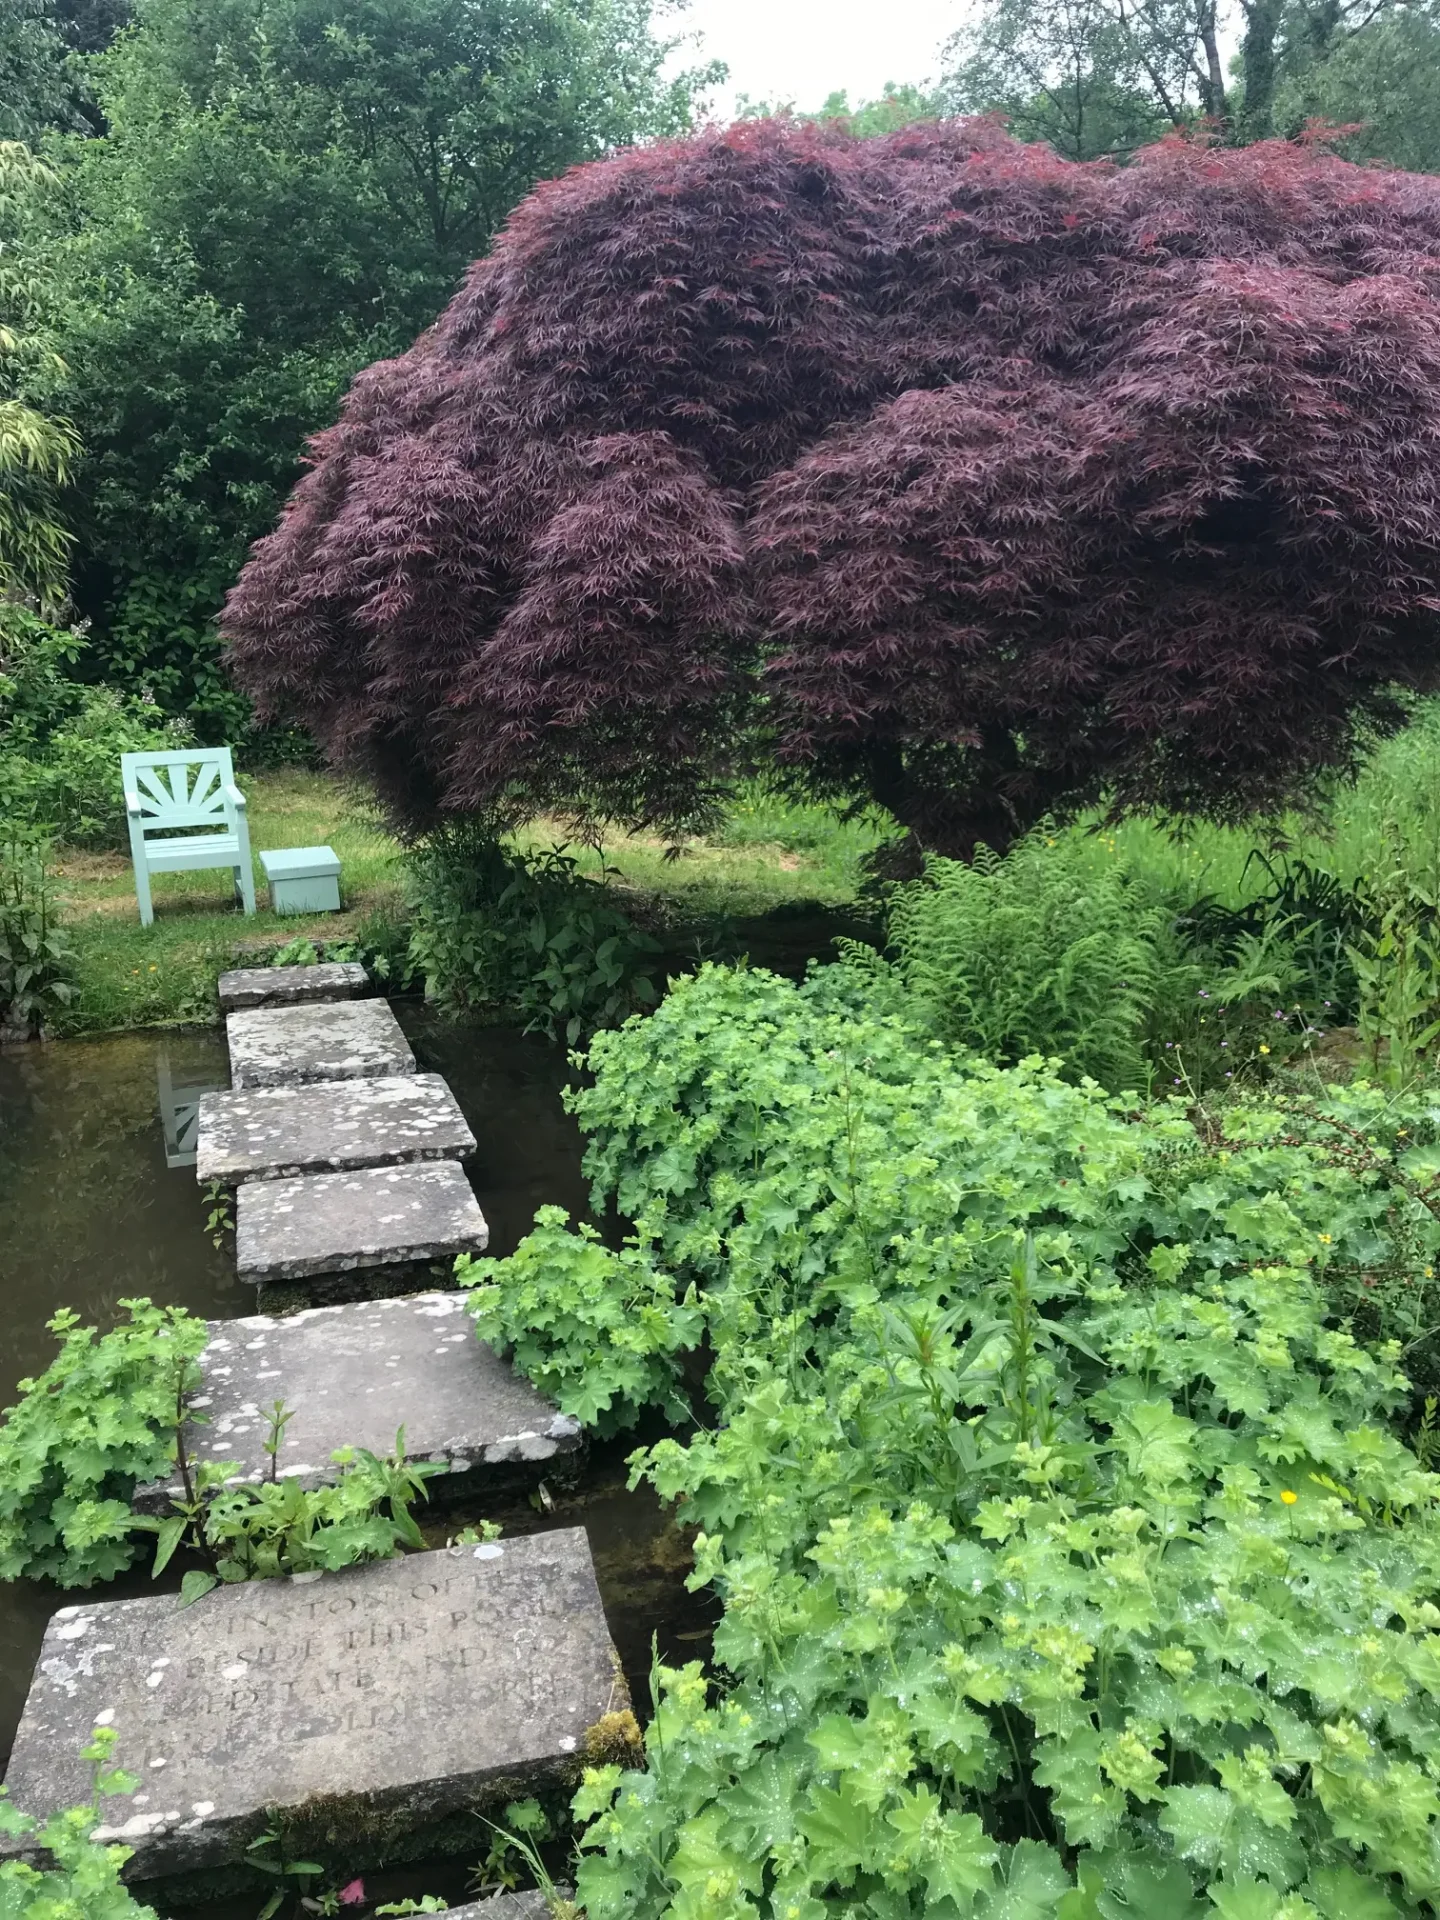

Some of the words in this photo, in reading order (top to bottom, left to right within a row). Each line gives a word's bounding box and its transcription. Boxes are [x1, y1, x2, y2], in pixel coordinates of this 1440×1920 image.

[186, 1638, 322, 1677] BESIDE
[343, 1619, 428, 1649] THIS
[398, 1646, 488, 1678] AND
